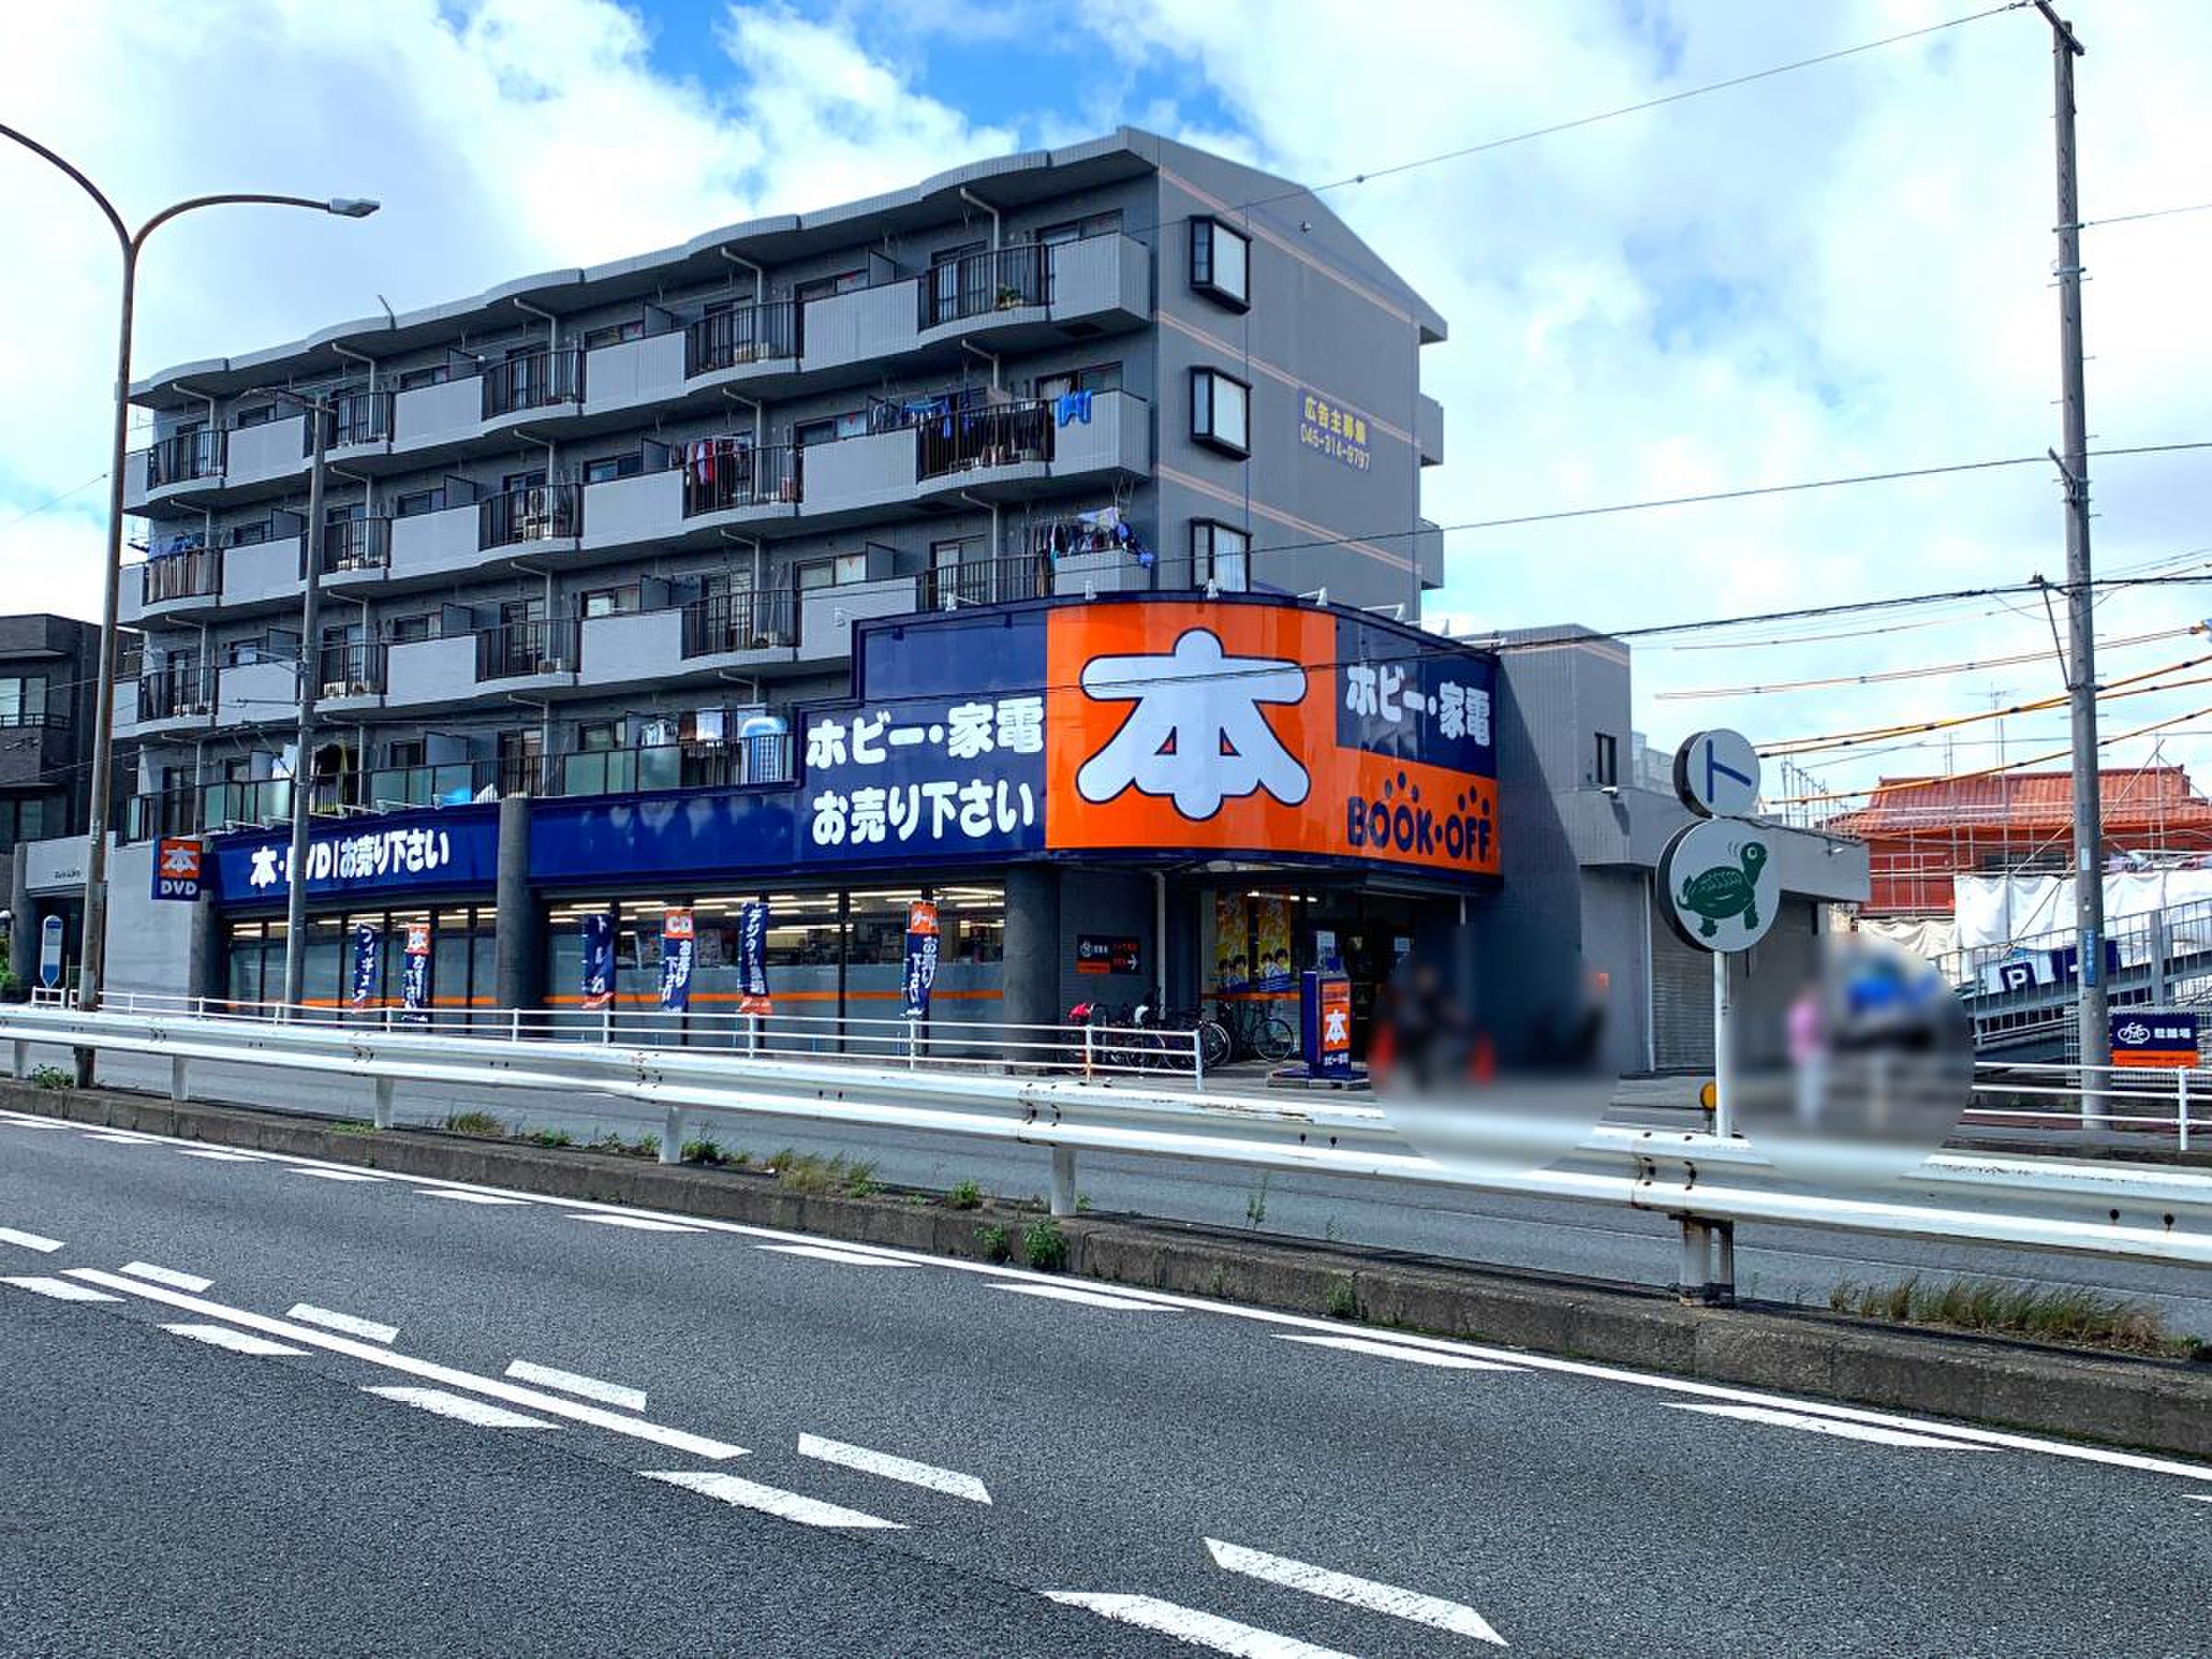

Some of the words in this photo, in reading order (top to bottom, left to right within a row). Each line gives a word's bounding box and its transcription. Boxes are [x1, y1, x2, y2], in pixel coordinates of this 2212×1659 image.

[1076, 627, 1311, 821] 本
[1346, 665, 1490, 747] ホビー・家電
[806, 697, 1043, 769] ホビー・家電
[812, 779, 1034, 845] お売り下さい
[161, 845, 197, 873] 本
[160, 880, 197, 895] DVD
[665, 916, 692, 934] CD
[2007, 969, 2027, 989] P
